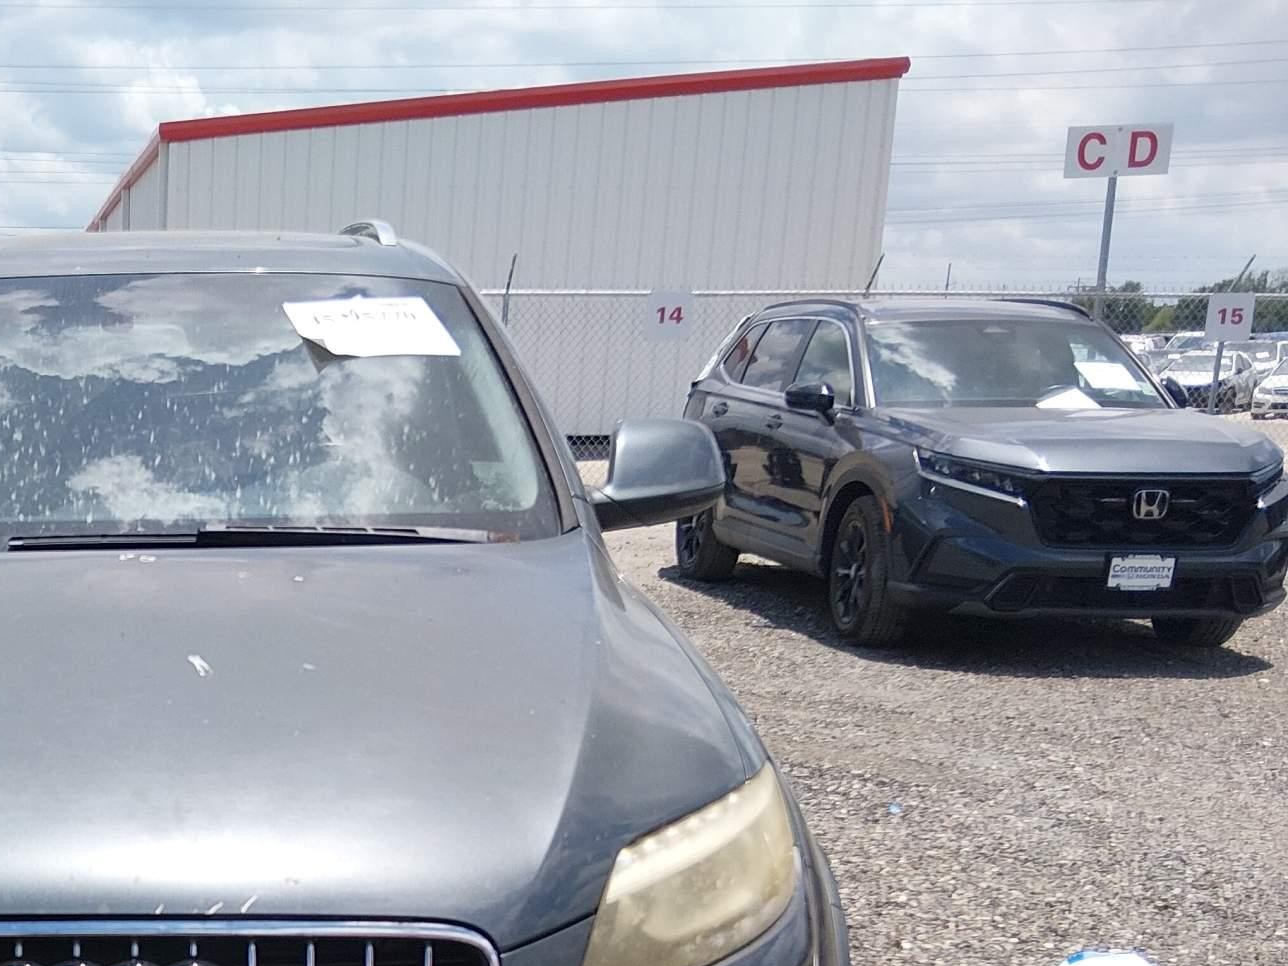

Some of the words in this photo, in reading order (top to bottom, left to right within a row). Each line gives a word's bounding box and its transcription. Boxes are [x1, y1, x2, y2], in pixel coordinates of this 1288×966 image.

[1078, 132, 1107, 170] C
[1127, 131, 1158, 168] D
[656, 306, 684, 324] 14
[1218, 308, 1244, 325] 15
